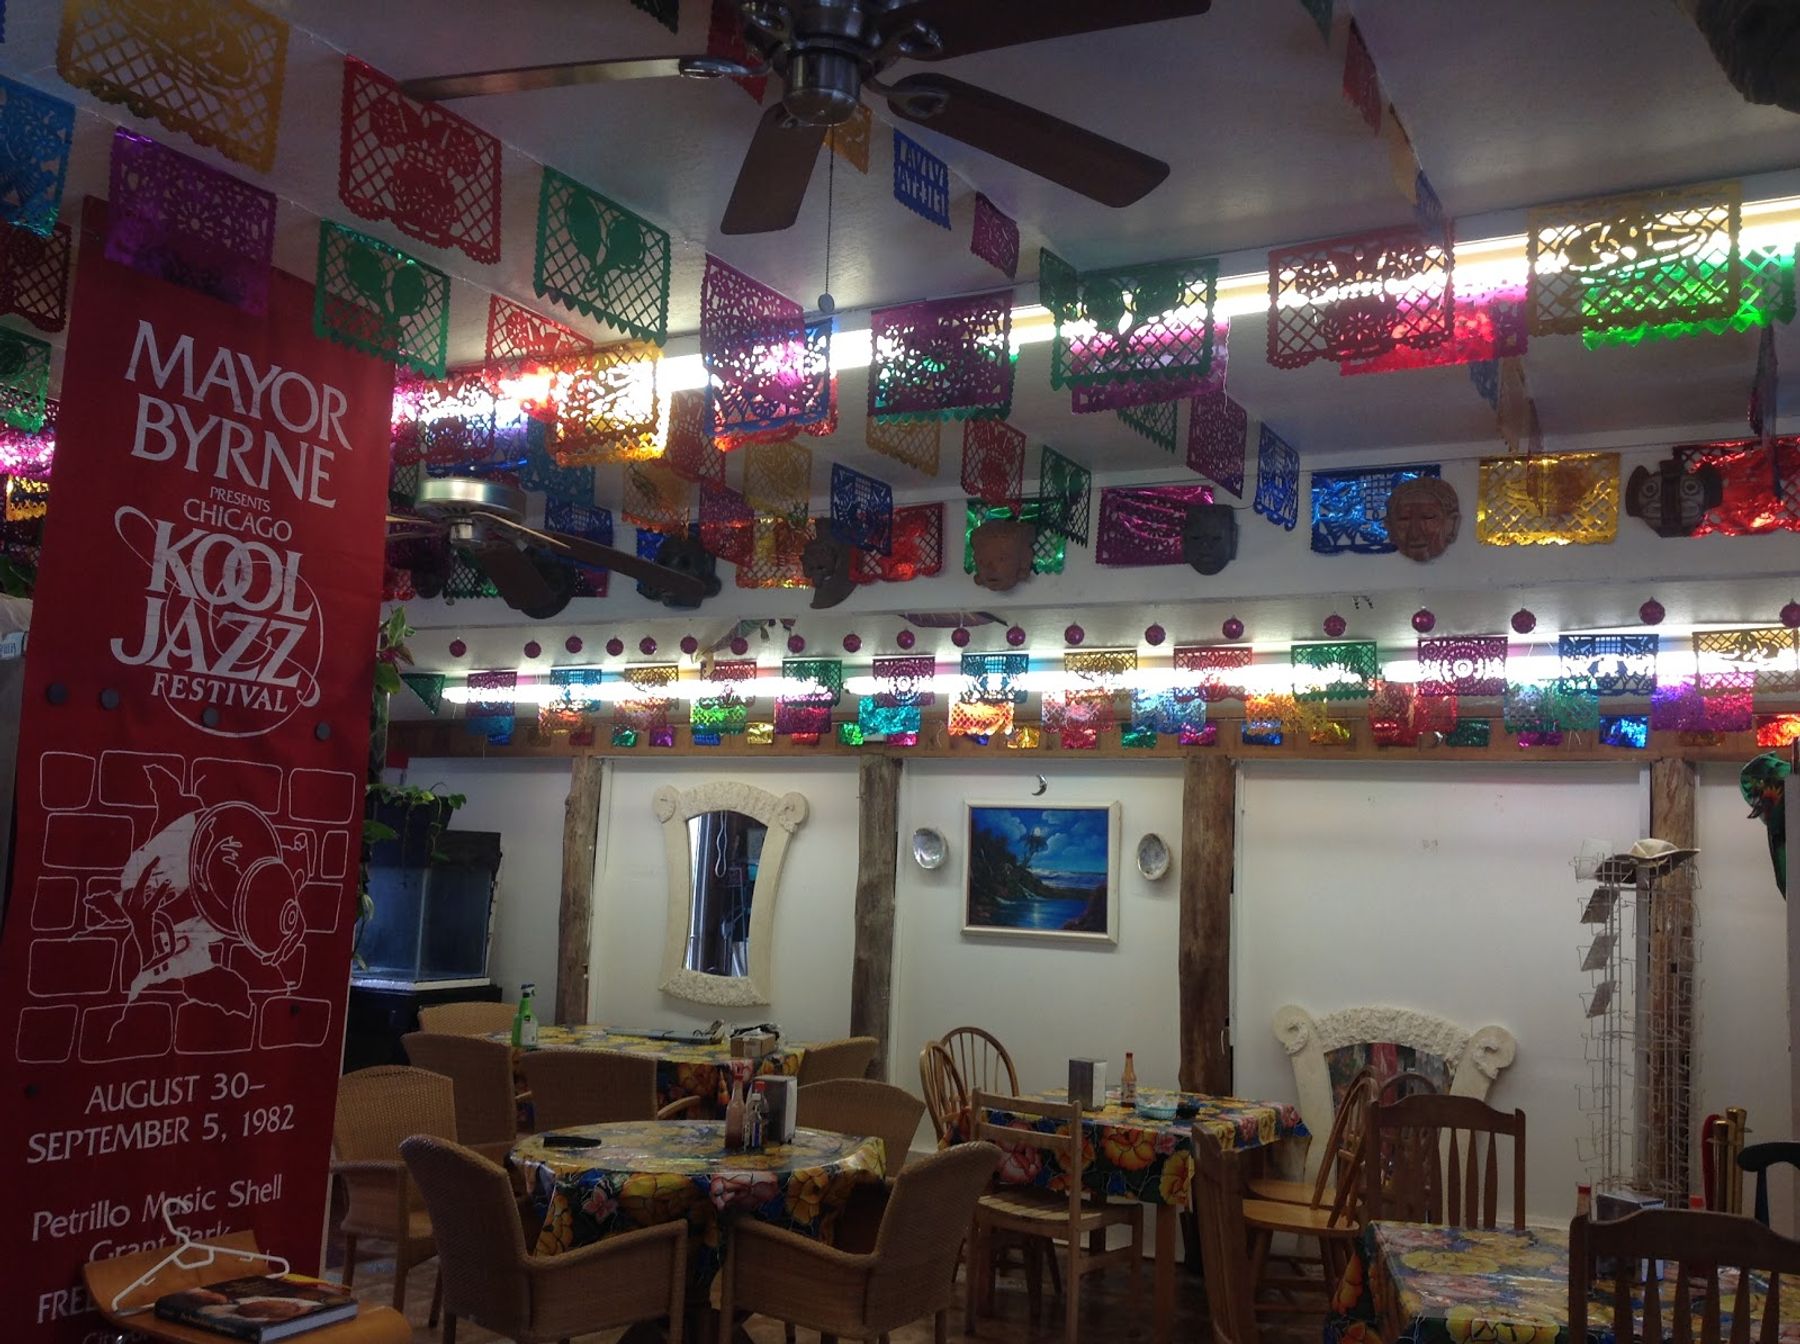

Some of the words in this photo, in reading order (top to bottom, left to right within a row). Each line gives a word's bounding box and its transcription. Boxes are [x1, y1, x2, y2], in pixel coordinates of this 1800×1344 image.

[124, 319, 352, 450] MAYOR
[131, 394, 337, 508] BYRNE
[183, 498, 293, 542] CHICAGO
[209, 486, 271, 512] PRESENTS
[145, 518, 315, 620] KOOL
[110, 596, 307, 688] JAZZ
[151, 672, 288, 713] FESTIVAL
[84, 1074, 200, 1116] AUGUST
[27, 1116, 190, 1165] SEPTEMBER
[201, 1112, 228, 1144] 5,
[242, 1103, 295, 1137] 1982
[31, 1199, 131, 1241] Petrillo
[227, 1173, 283, 1208] Shell
